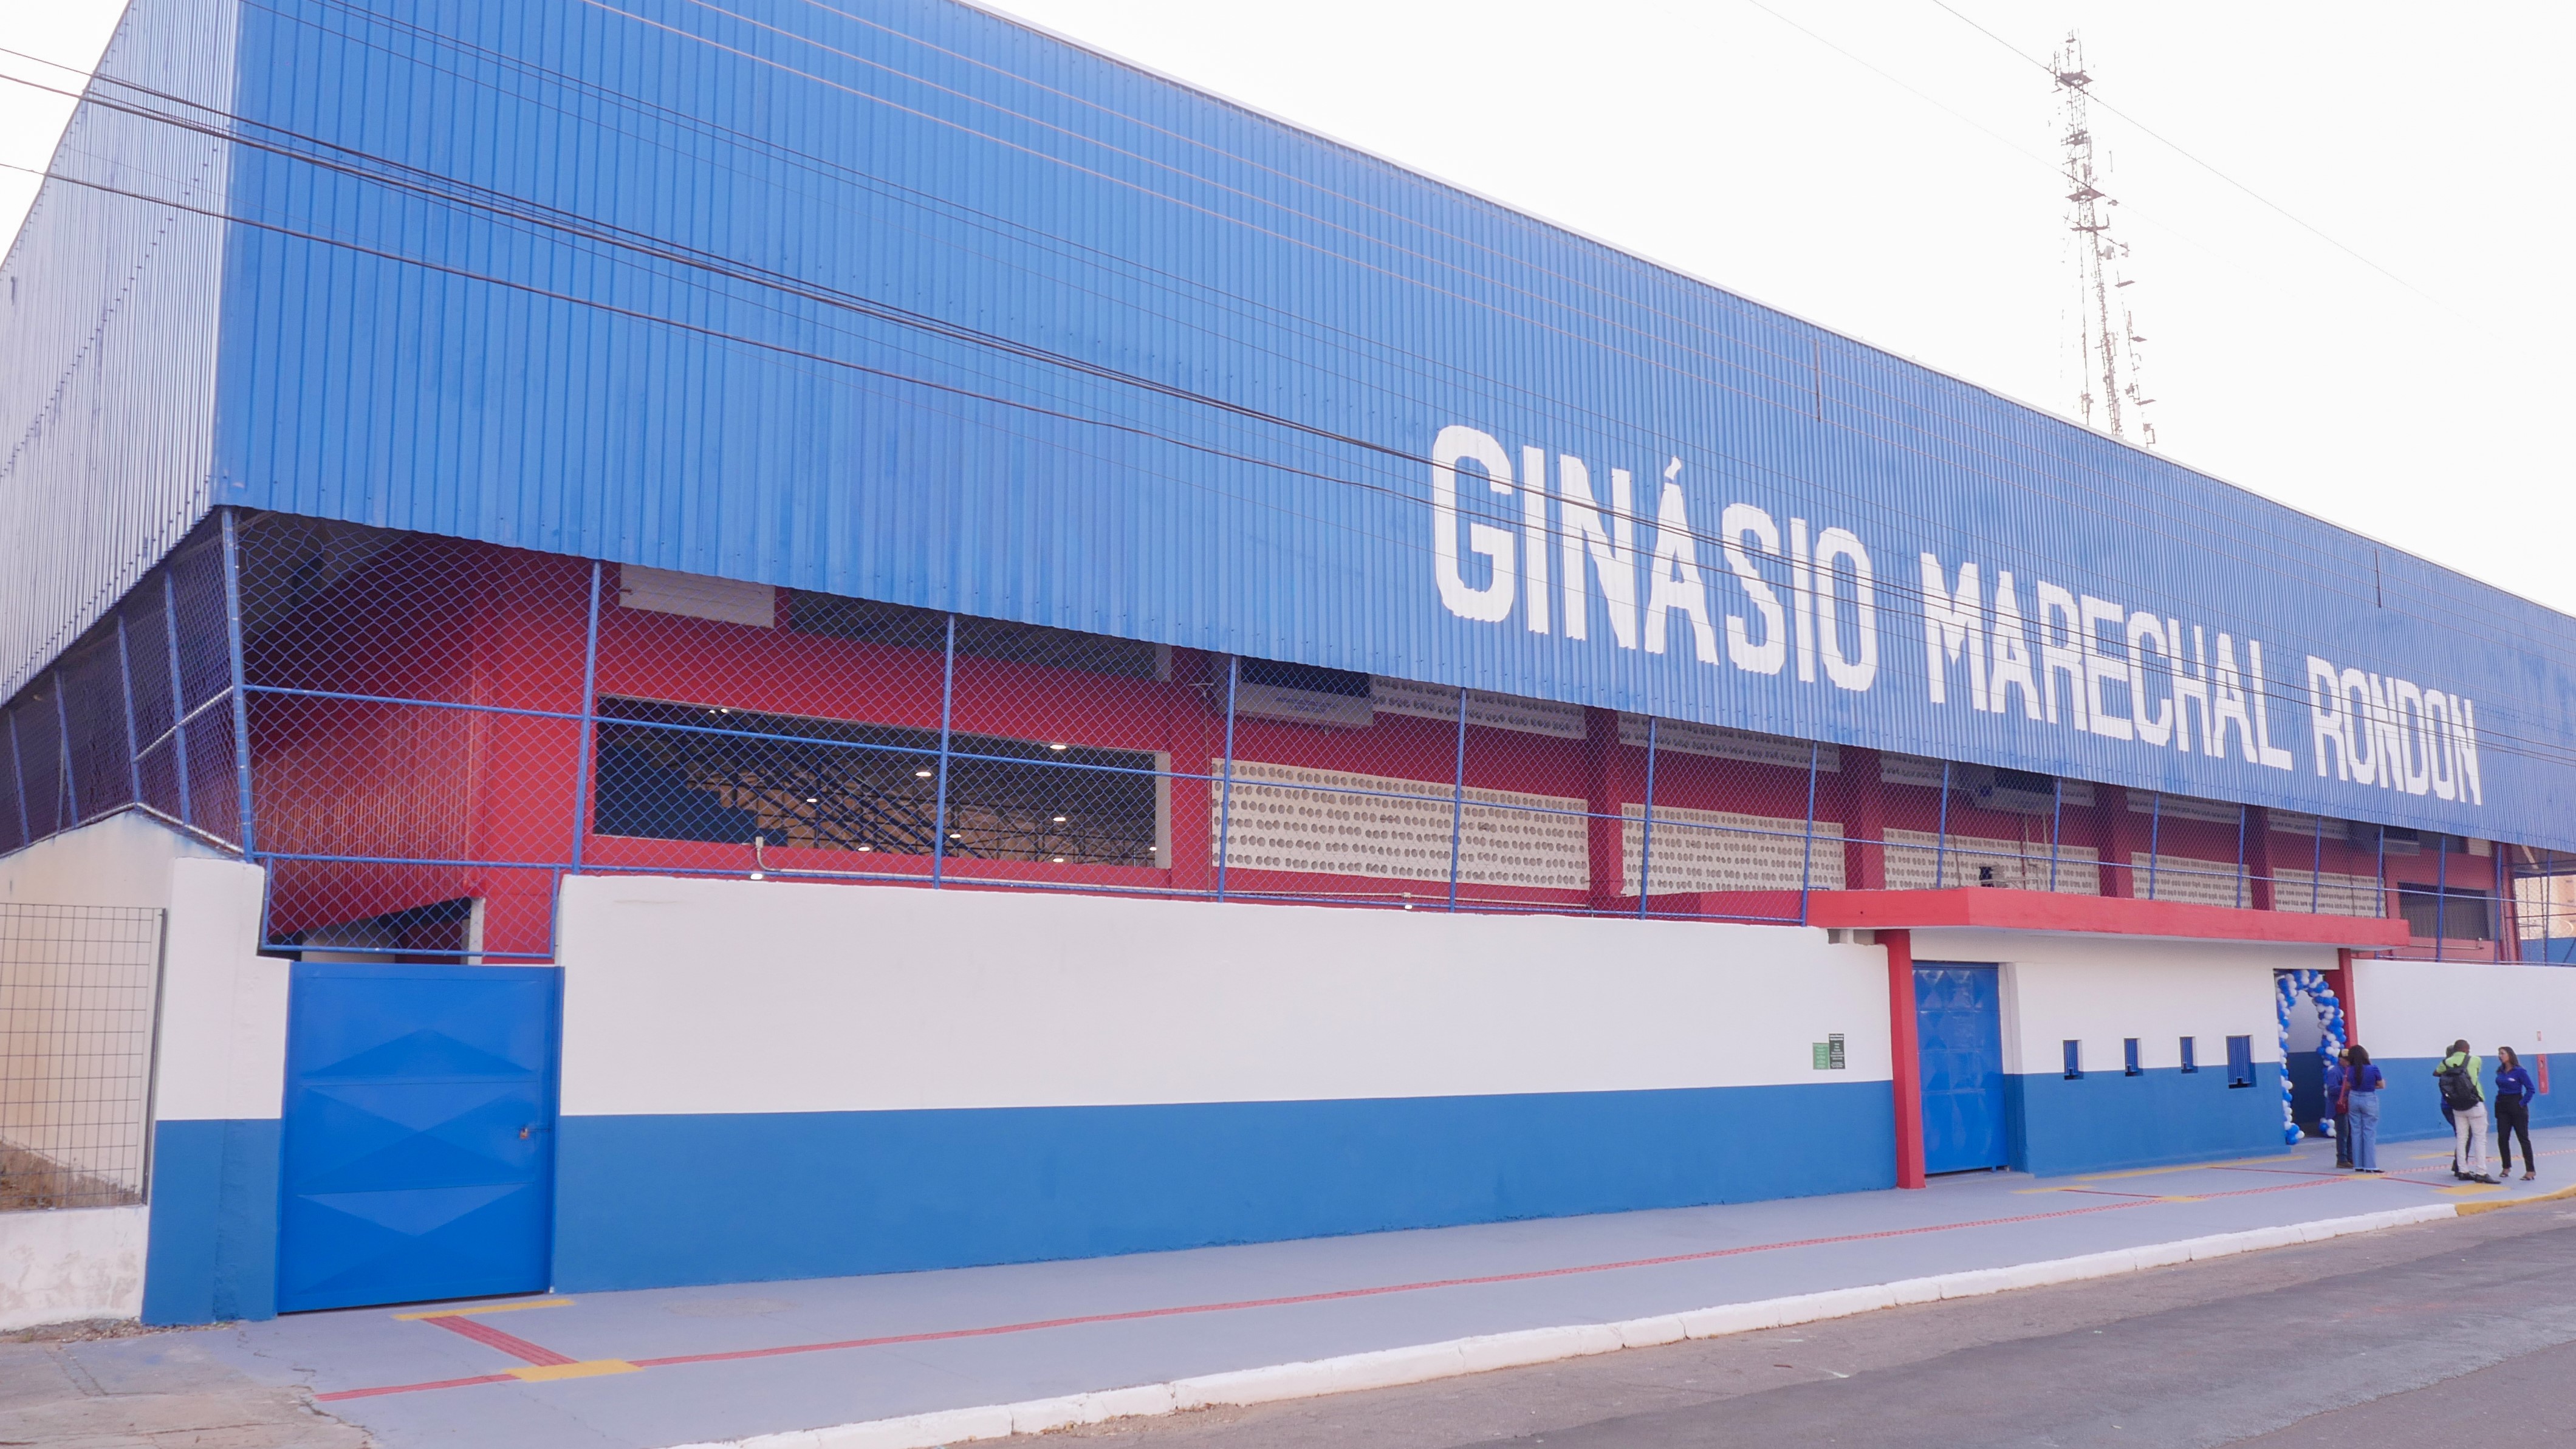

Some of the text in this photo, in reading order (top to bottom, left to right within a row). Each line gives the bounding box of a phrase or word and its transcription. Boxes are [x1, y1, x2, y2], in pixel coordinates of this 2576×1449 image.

[1433, 425, 2482, 806] GINÁSIO MARECHAL RONDON
